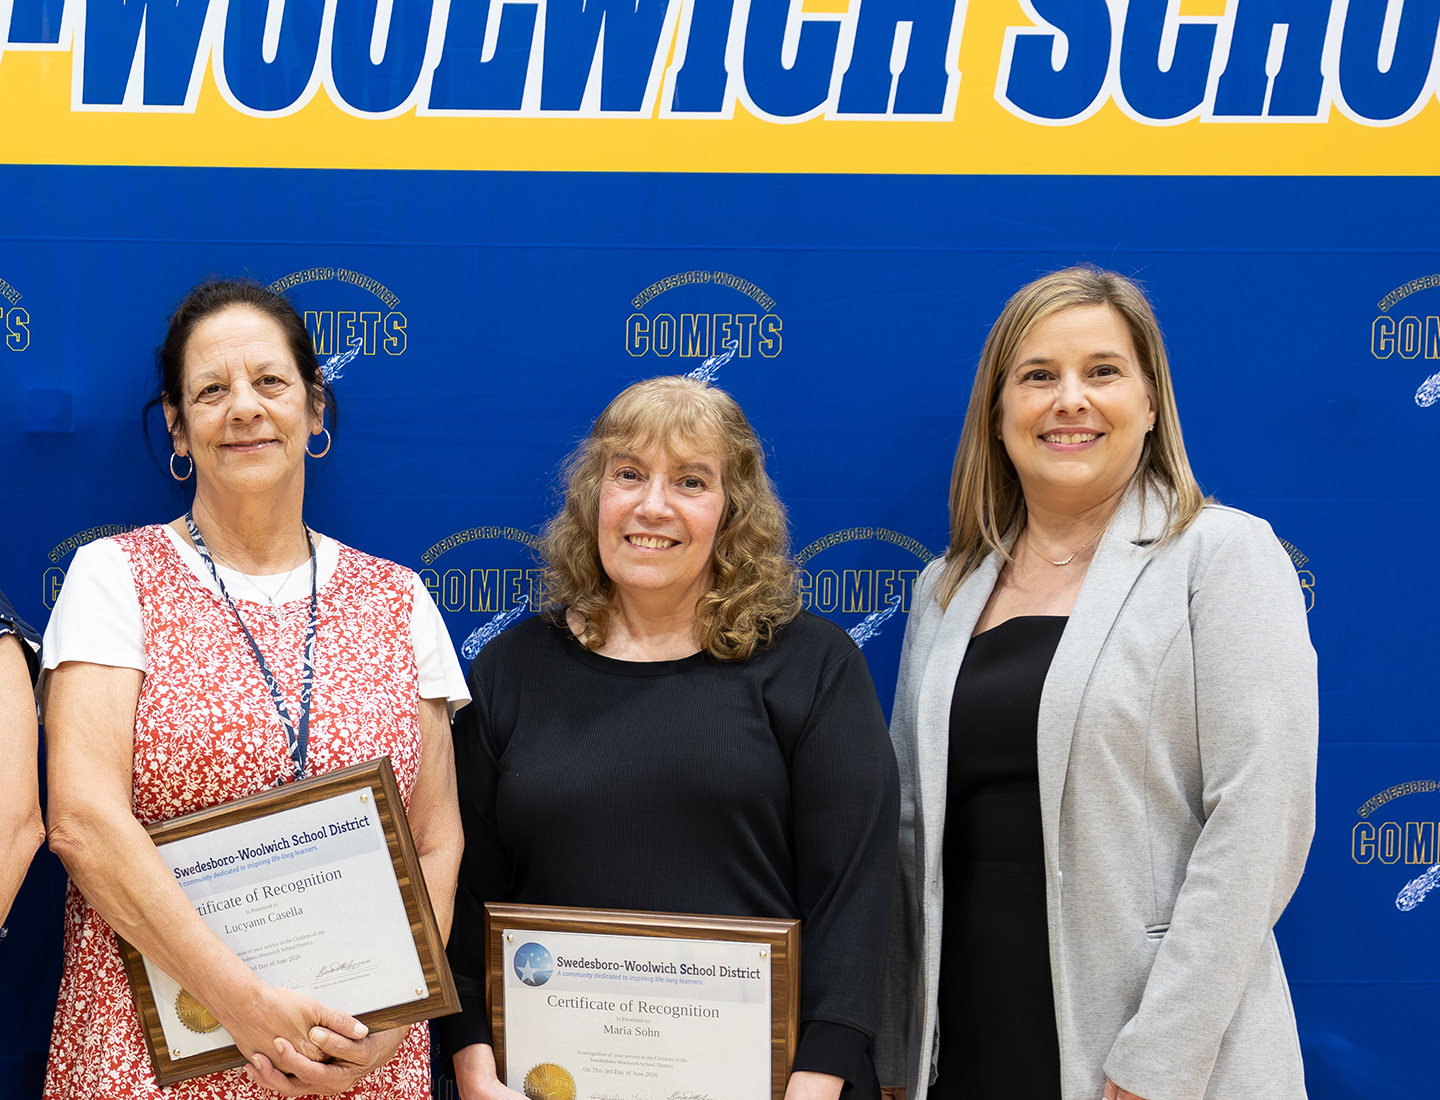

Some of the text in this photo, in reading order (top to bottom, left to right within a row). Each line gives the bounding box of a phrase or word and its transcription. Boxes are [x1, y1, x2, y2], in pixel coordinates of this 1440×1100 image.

[994, 0, 1440, 127] SCHO
[264, 267, 401, 310] EDESBORO-WOOLWICH
[631, 270, 777, 312] SWEDESBORO-WOOLWICH
[303, 310, 408, 356] METS
[625, 313, 783, 359] COMETS
[418, 568, 547, 613] COMET
[798, 569, 920, 613] COMET
[1357, 780, 1440, 818] SWEDESBORO-
[173, 815, 370, 879] Swedesboro-Woolwich School District
[1351, 821, 1440, 864] COM
[195, 869, 342, 916] tificate of Recognition
[224, 906, 304, 934] Lucyann Casella
[556, 956, 761, 980] Swedesboro-Woolwich School District
[561, 971, 593, 980] community
[593, 972, 622, 980] dedicated
[629, 974, 654, 983] inspiring
[654, 975, 678, 985] life-long
[546, 994, 719, 1019] Certificate of Recognition
[603, 1024, 660, 1037] Maria Sohn
